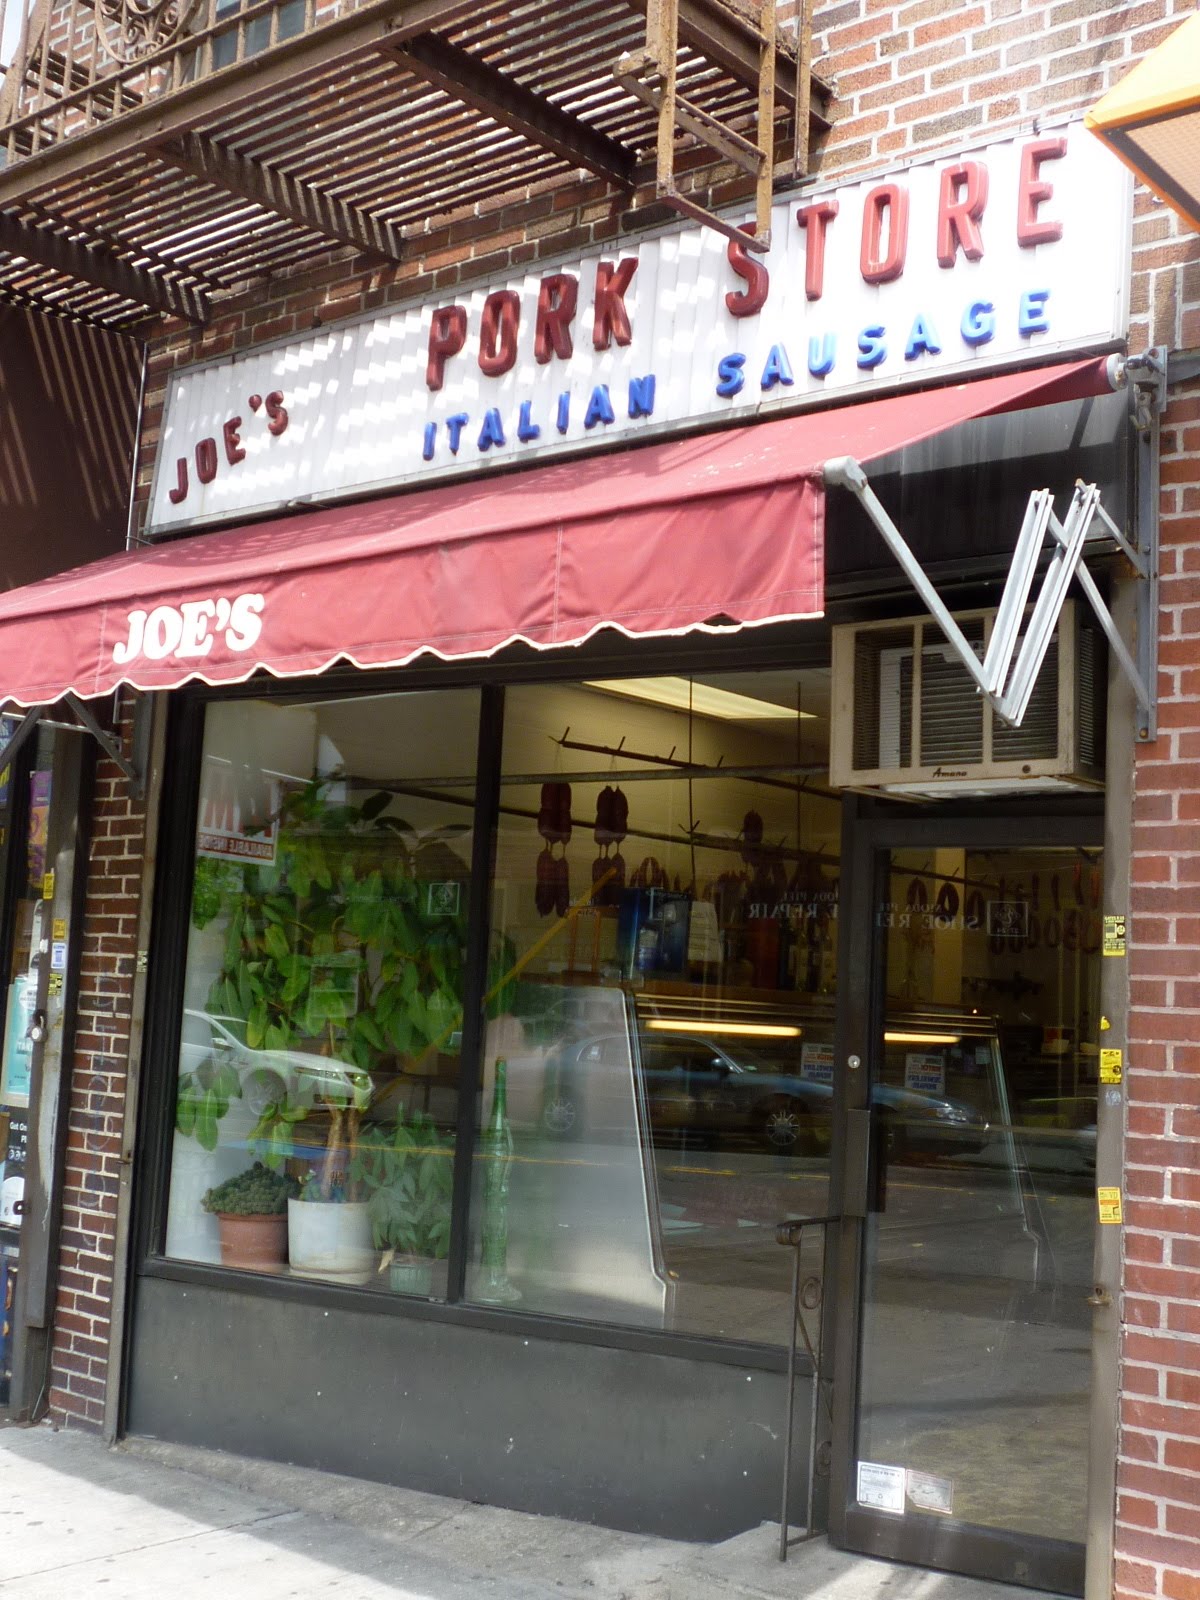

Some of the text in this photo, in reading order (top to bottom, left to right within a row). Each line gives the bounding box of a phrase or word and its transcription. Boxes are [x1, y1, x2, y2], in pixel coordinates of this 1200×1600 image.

[169, 137, 1069, 505] JOE'S PORK STORE
[422, 288, 1051, 461] ITALIAN SAUSAGE
[112, 592, 265, 665] JOE'S
[932, 766, 968, 778] Amana
